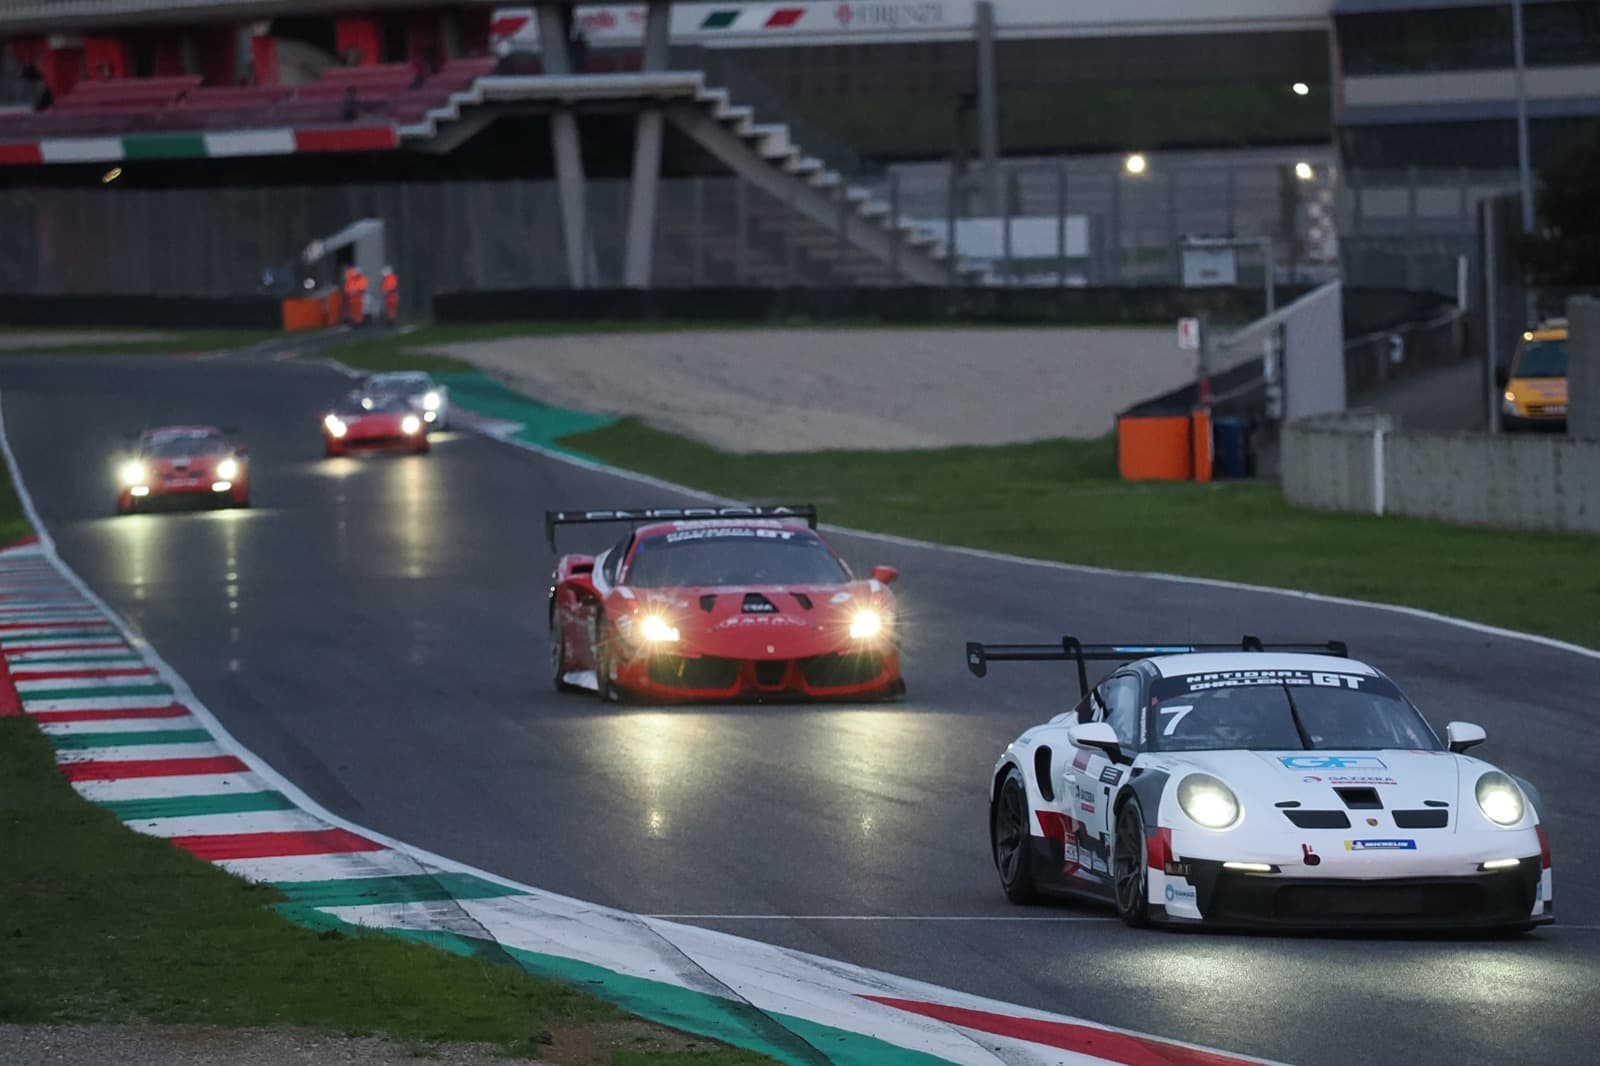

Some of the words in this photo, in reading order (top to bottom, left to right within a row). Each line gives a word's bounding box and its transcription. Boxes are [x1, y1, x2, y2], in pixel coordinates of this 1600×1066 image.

[1186, 671, 1309, 683] NATIONAL
[1189, 678, 1311, 691] CHALLENGE
[1312, 672, 1365, 689] GT
[1160, 705, 1194, 736] 7
